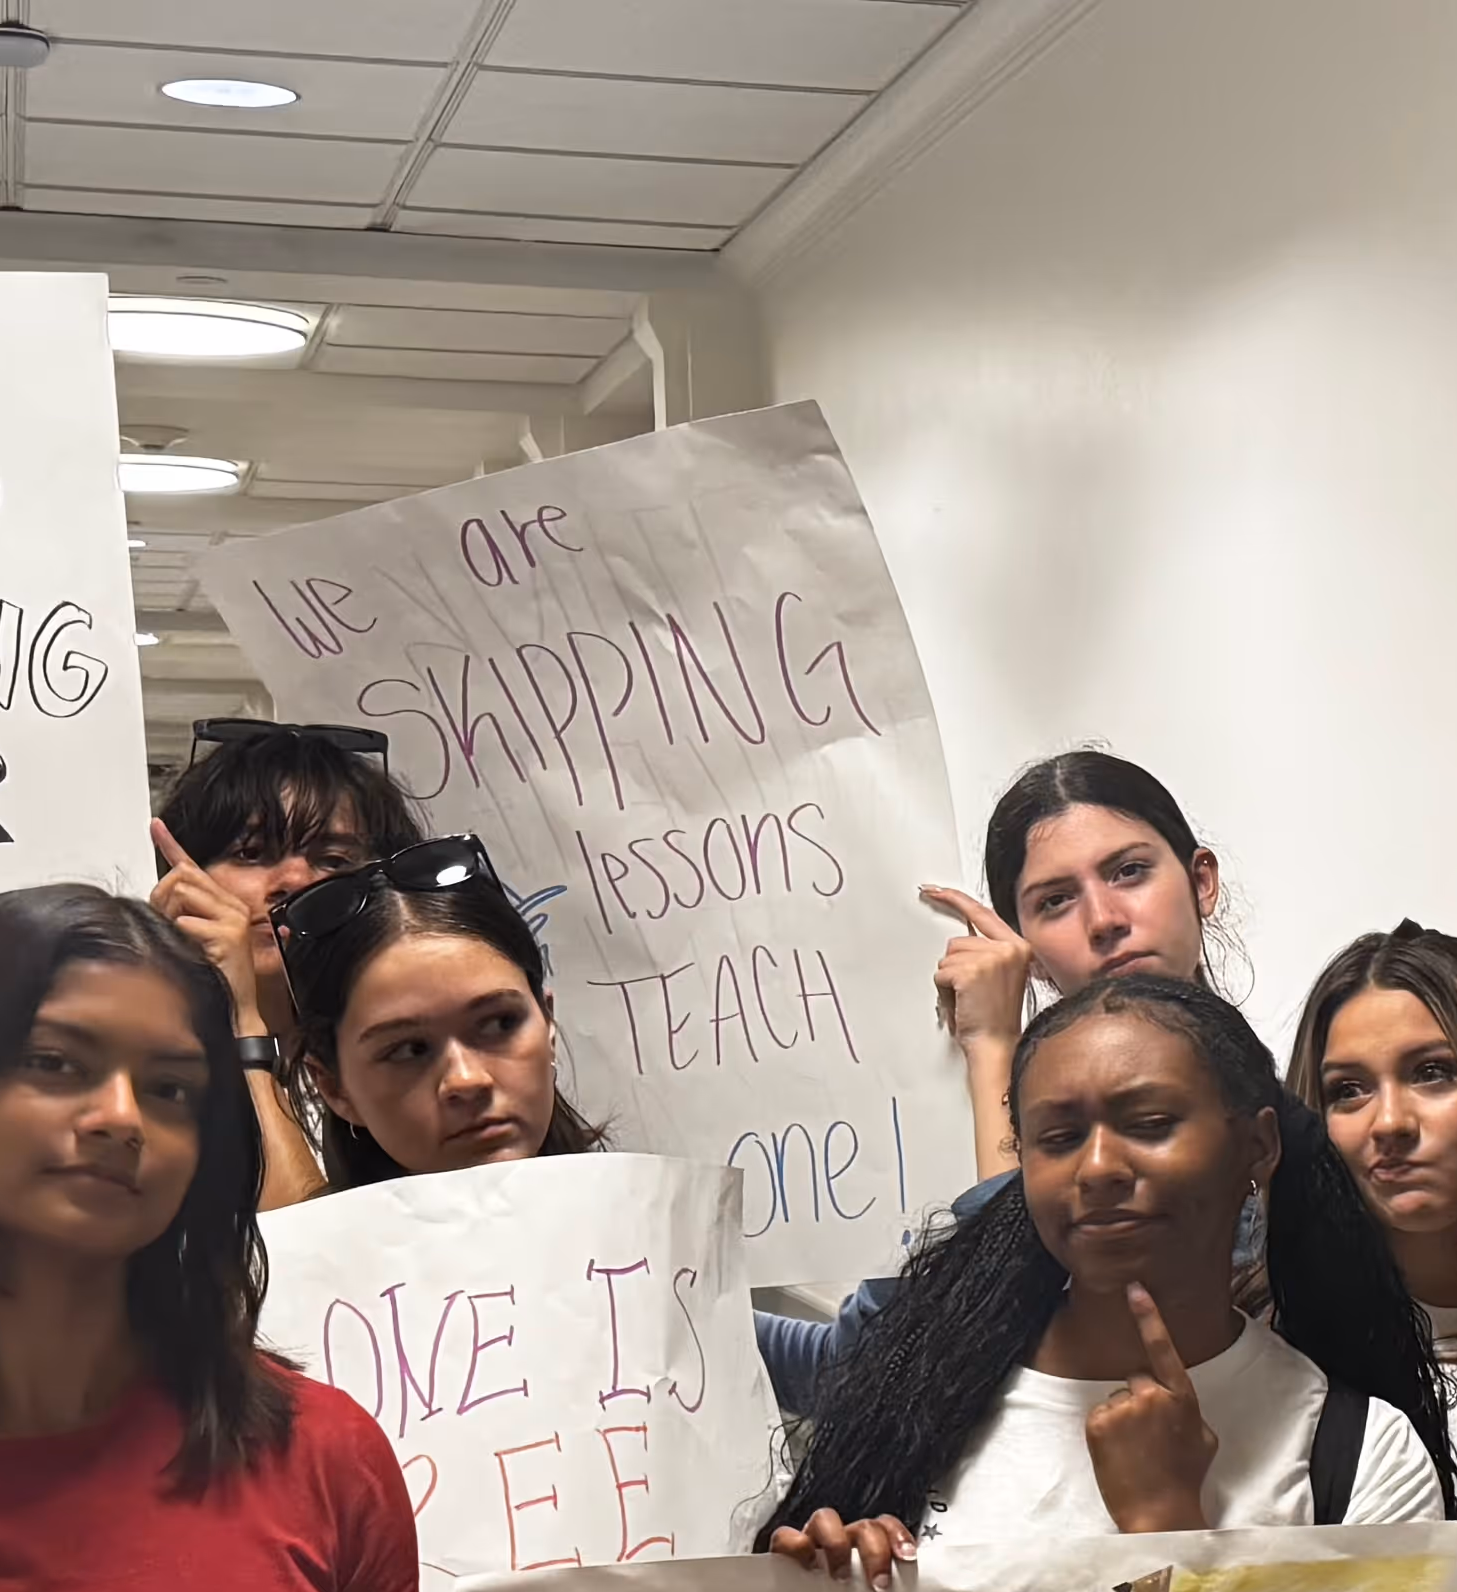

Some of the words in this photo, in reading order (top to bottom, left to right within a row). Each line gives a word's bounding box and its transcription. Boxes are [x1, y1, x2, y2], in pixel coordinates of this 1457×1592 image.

[460, 504, 584, 587] are
[357, 591, 881, 811] SKIPPING
[576, 802, 845, 934] lessons
[586, 949, 860, 1075] TEACH
[587, 1257, 706, 1413] IS
